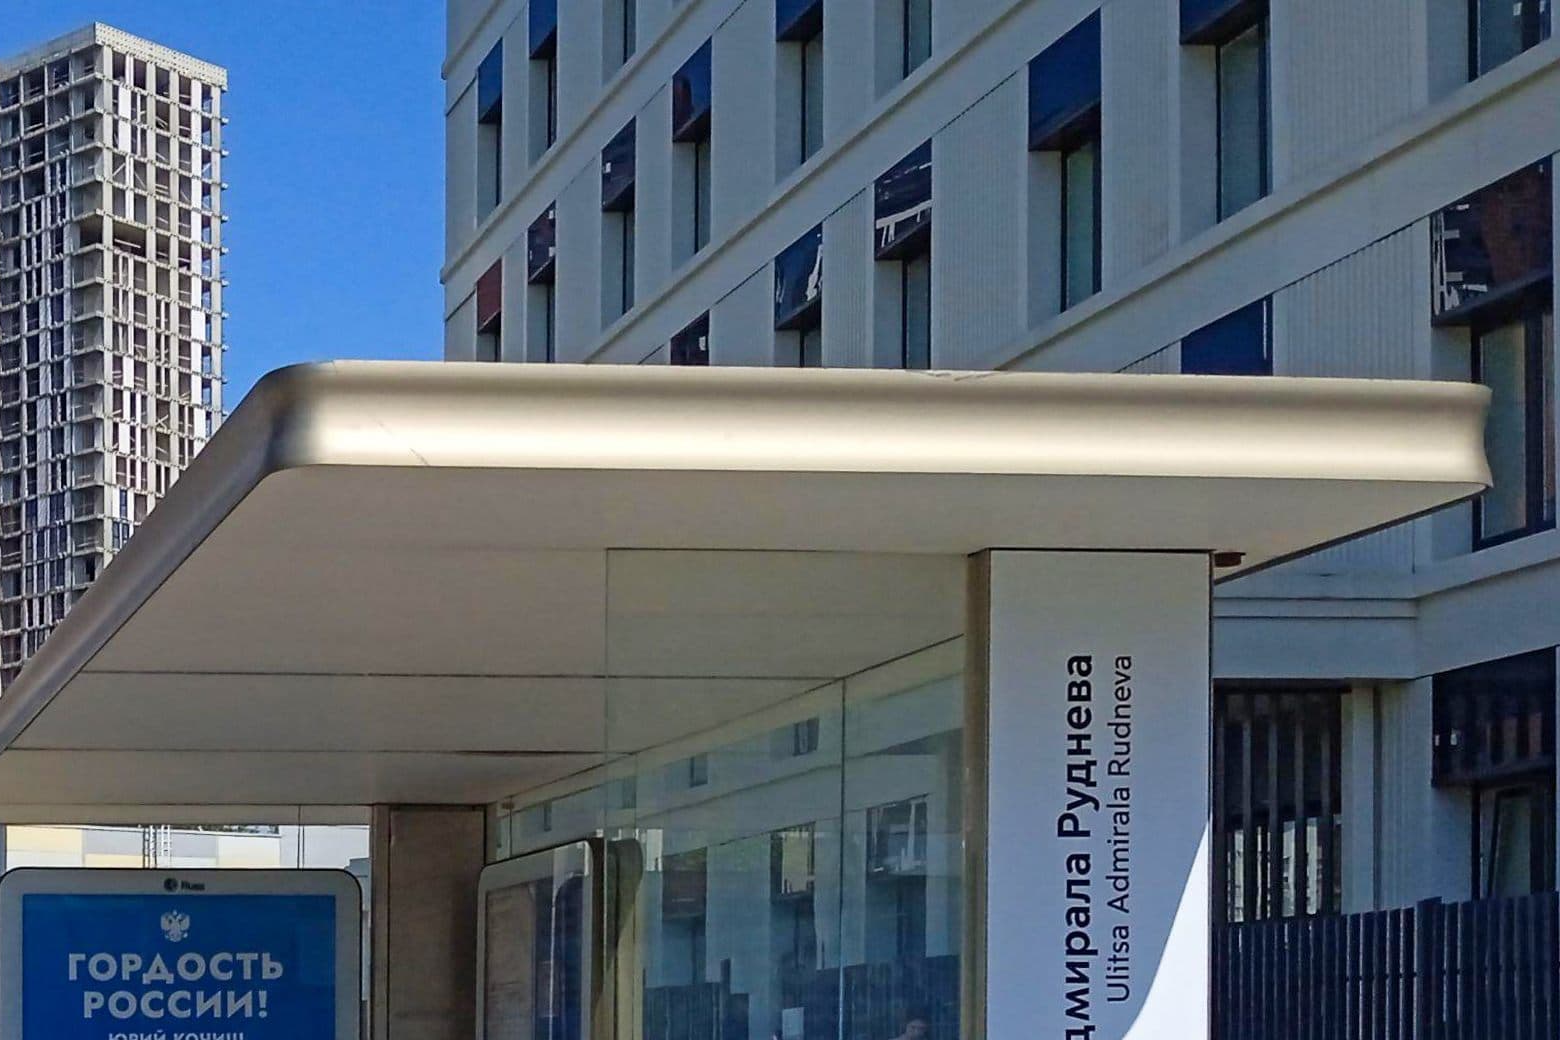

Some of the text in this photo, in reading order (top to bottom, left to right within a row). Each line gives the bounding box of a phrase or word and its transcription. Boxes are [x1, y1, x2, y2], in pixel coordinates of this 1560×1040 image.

[1057, 655, 1100, 838] Руднева
[1106, 655, 1133, 1003] Ulitsa Admirala Rudneva
[68, 952, 284, 985] ГОРДОСТЬ
[83, 990, 268, 1019] РОССИИ!
